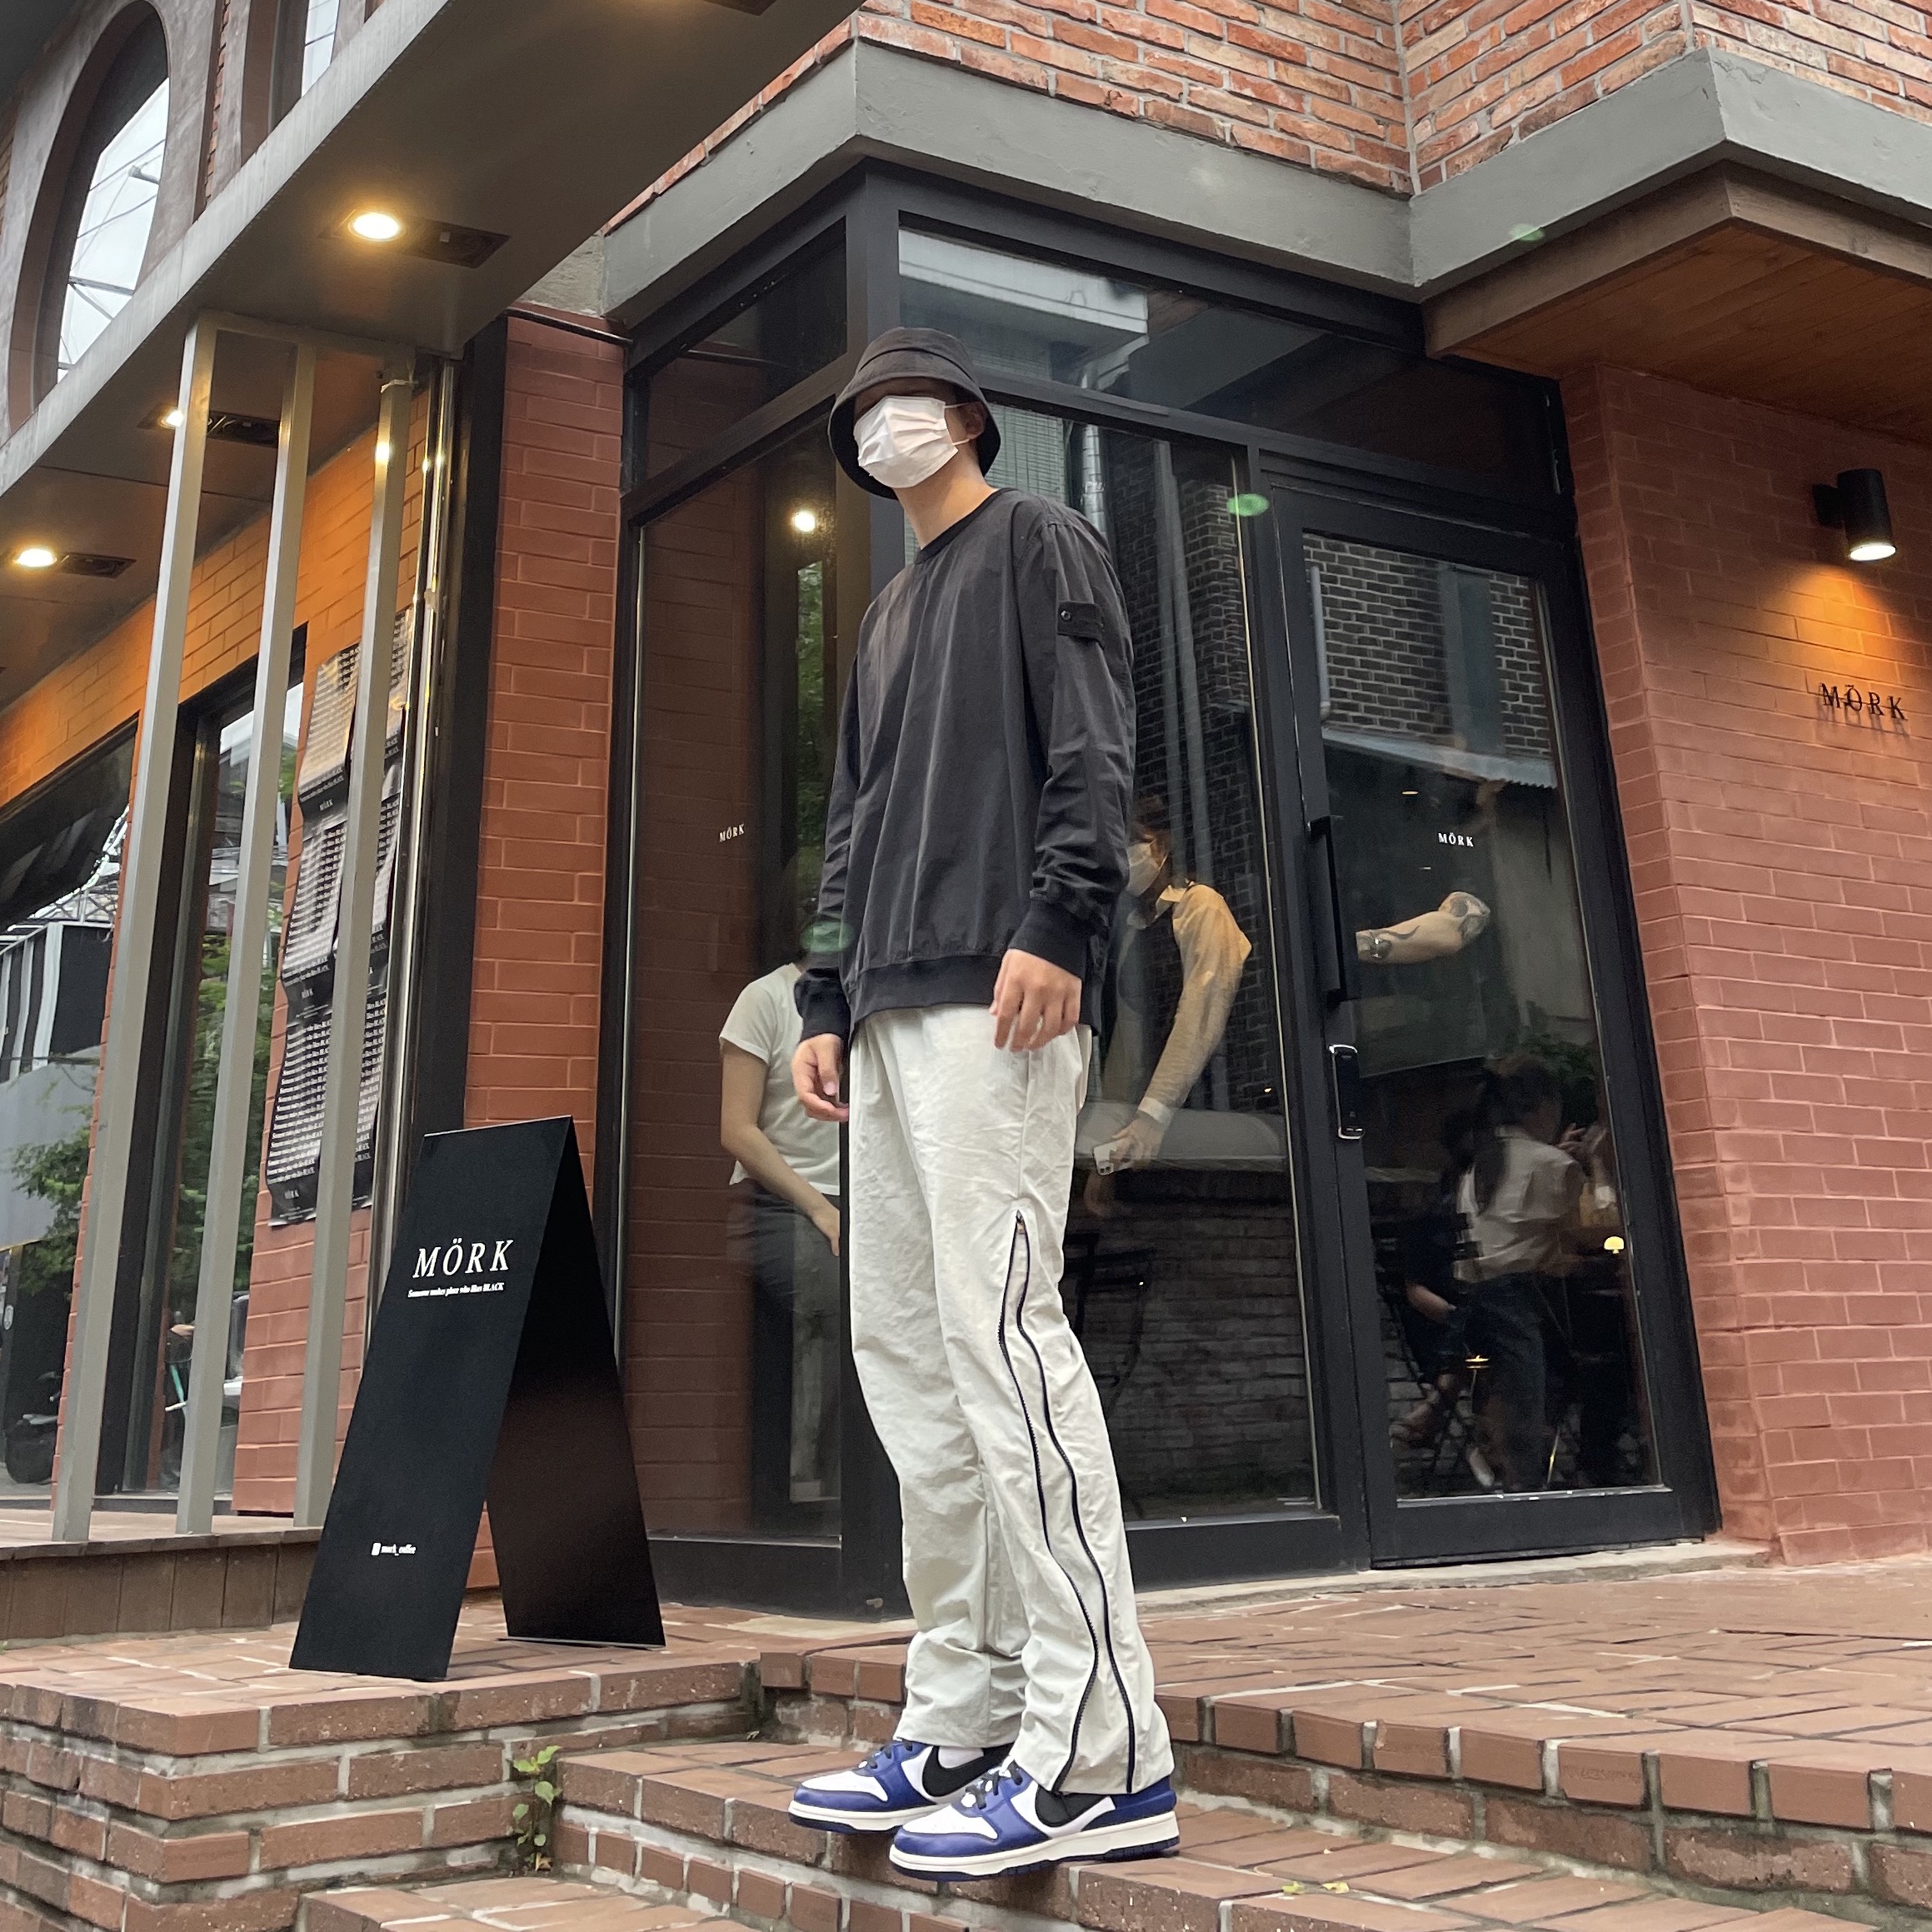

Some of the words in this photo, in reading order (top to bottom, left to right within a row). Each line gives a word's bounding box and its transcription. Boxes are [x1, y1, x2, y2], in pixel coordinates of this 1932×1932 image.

[1820, 682, 1909, 721] MÖRK
[719, 823, 745, 842] MÖRK
[1438, 832, 1474, 847] MÖRK
[412, 1238, 514, 1278] MÖRK
